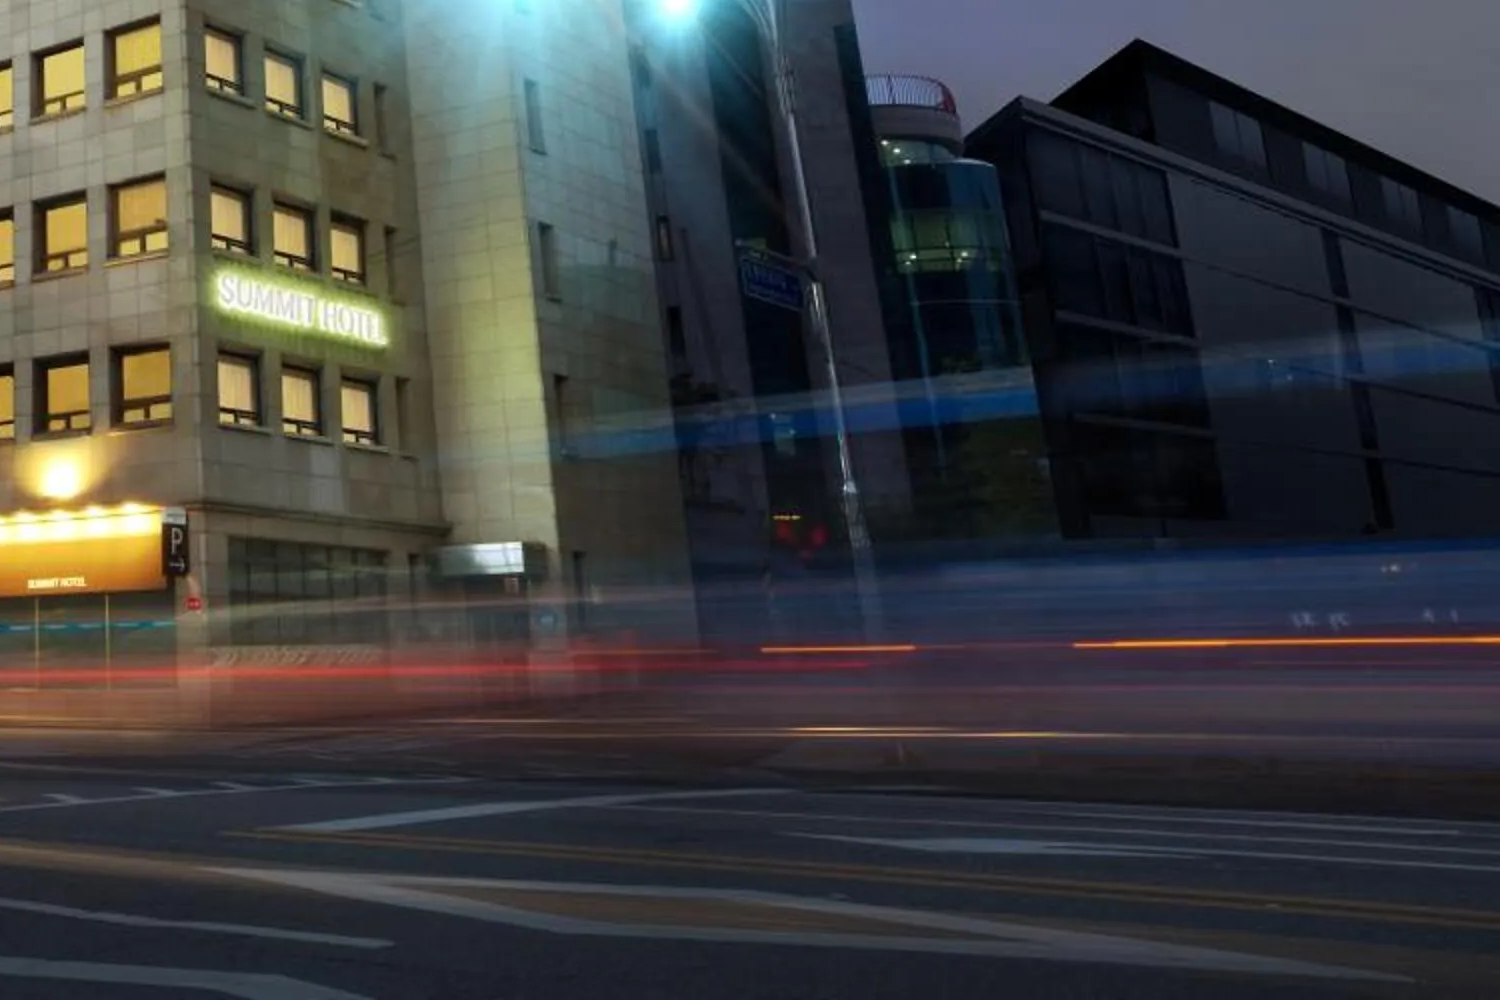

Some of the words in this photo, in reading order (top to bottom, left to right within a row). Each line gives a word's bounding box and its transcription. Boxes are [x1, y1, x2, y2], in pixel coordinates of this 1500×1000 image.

[219, 273, 316, 326] SUMMIT
[321, 301, 388, 346] HOTEL
[171, 527, 184, 555] P
